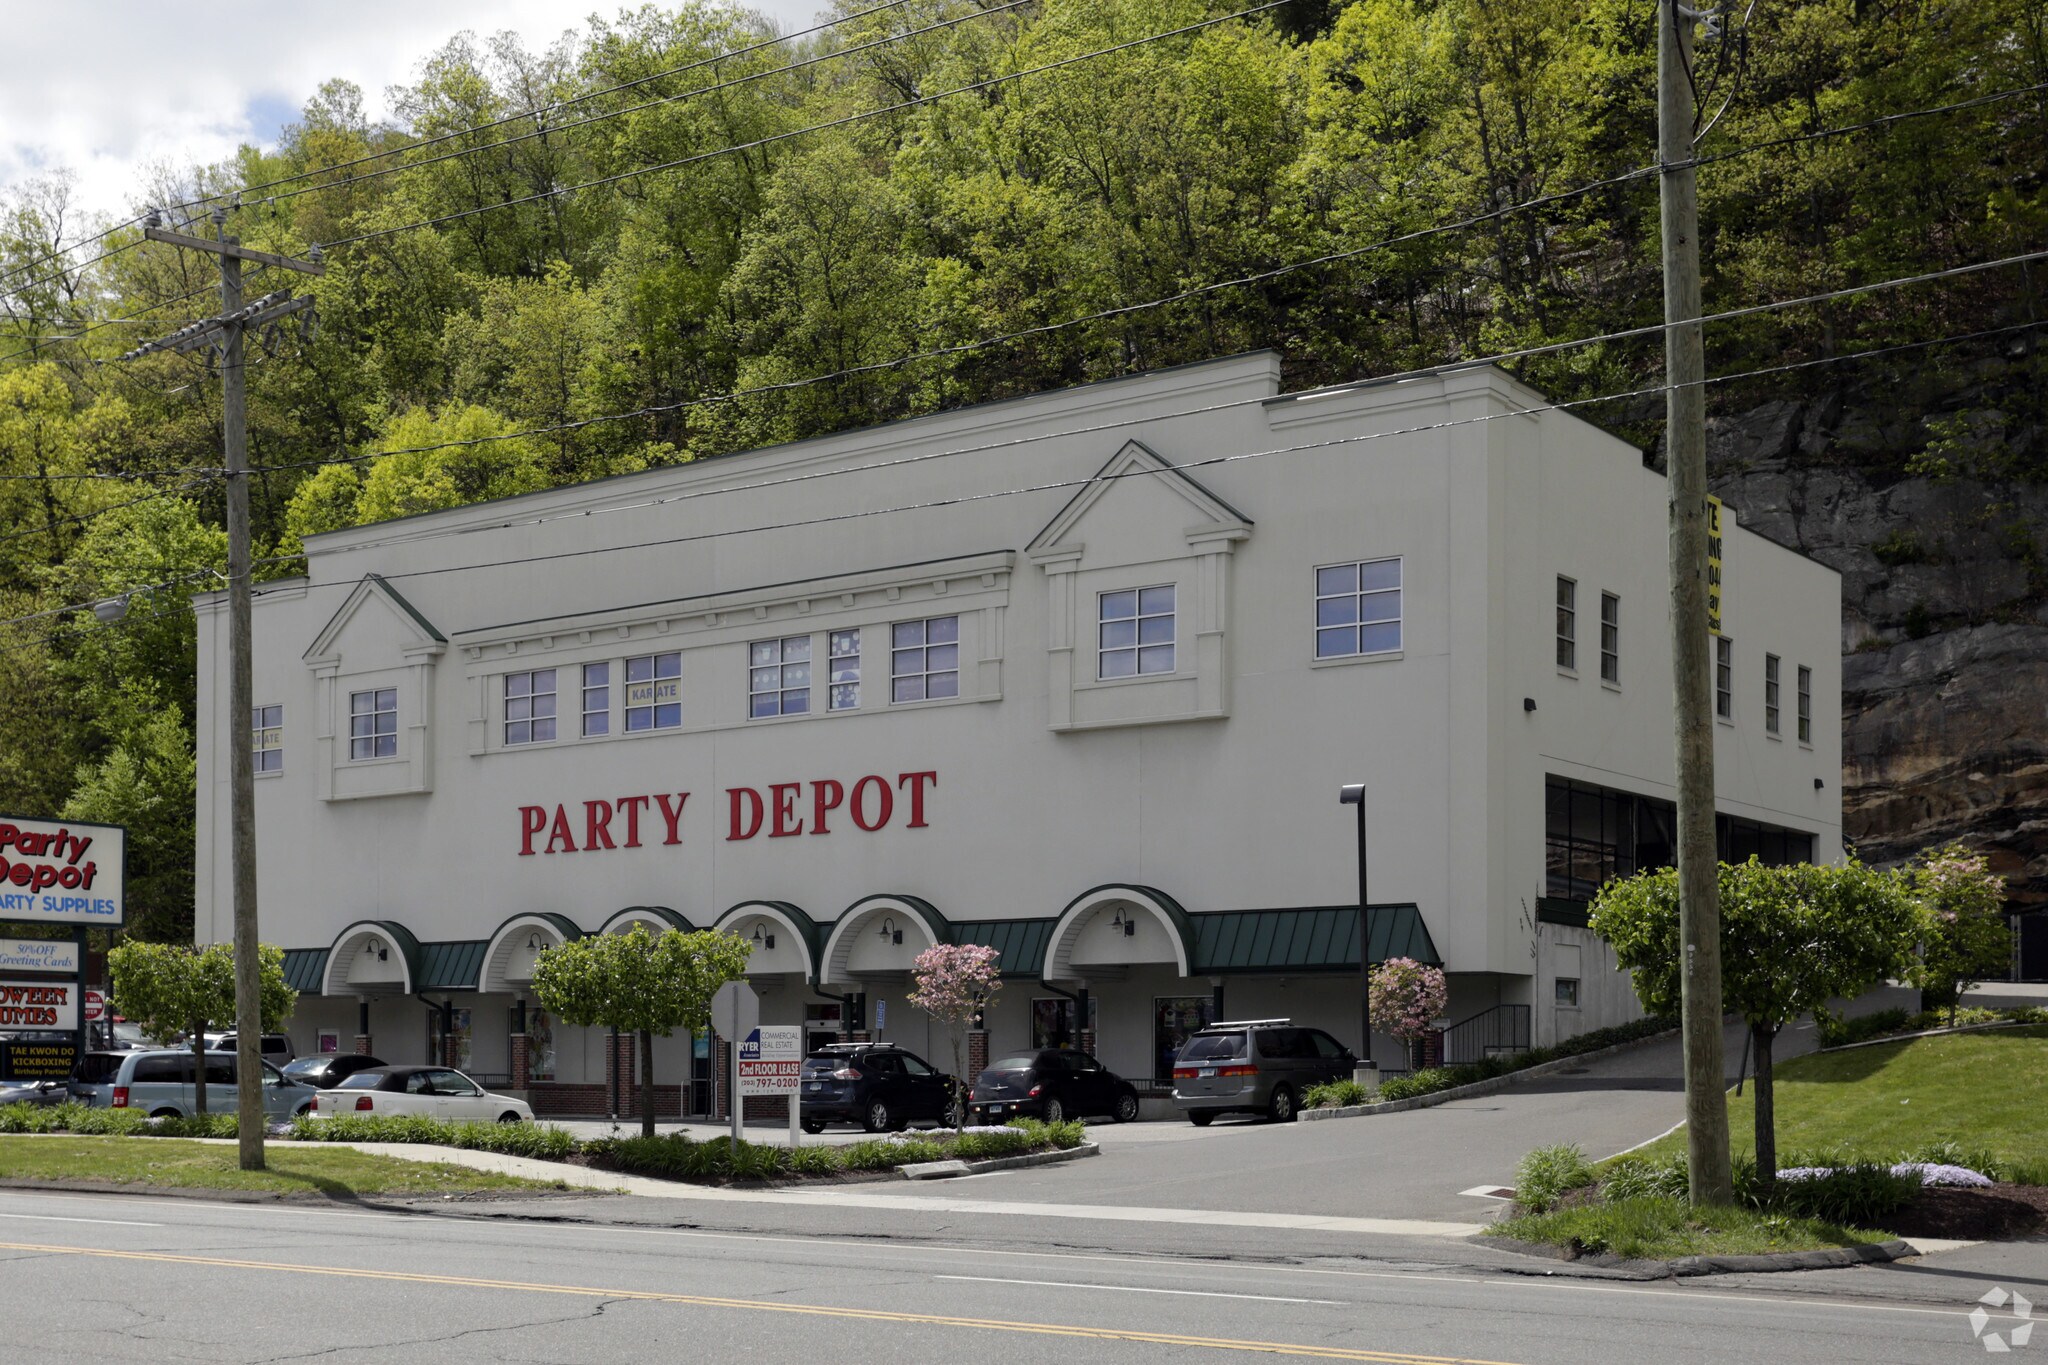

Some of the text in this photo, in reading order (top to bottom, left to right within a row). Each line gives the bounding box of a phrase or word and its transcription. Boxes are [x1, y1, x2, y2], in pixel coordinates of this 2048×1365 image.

[632, 684, 677, 700] KARATE
[518, 771, 937, 856] PARTY DEPOT
[0, 824, 93, 865] Party
[42, 895, 115, 915] SUPPLIES
[0, 953, 73, 967] Greeting Cards
[761, 1031, 798, 1039] COMMERCIAL
[761, 1041, 774, 1049] REAL
[10, 1046, 75, 1055] TAE KWON DO
[12, 1057, 72, 1066] KICKBOXING
[14, 1068, 43, 1076] Birthday
[741, 1063, 799, 1075] 2nd FLOOR LEASE
[756, 1079, 798, 1087] 797-0200
